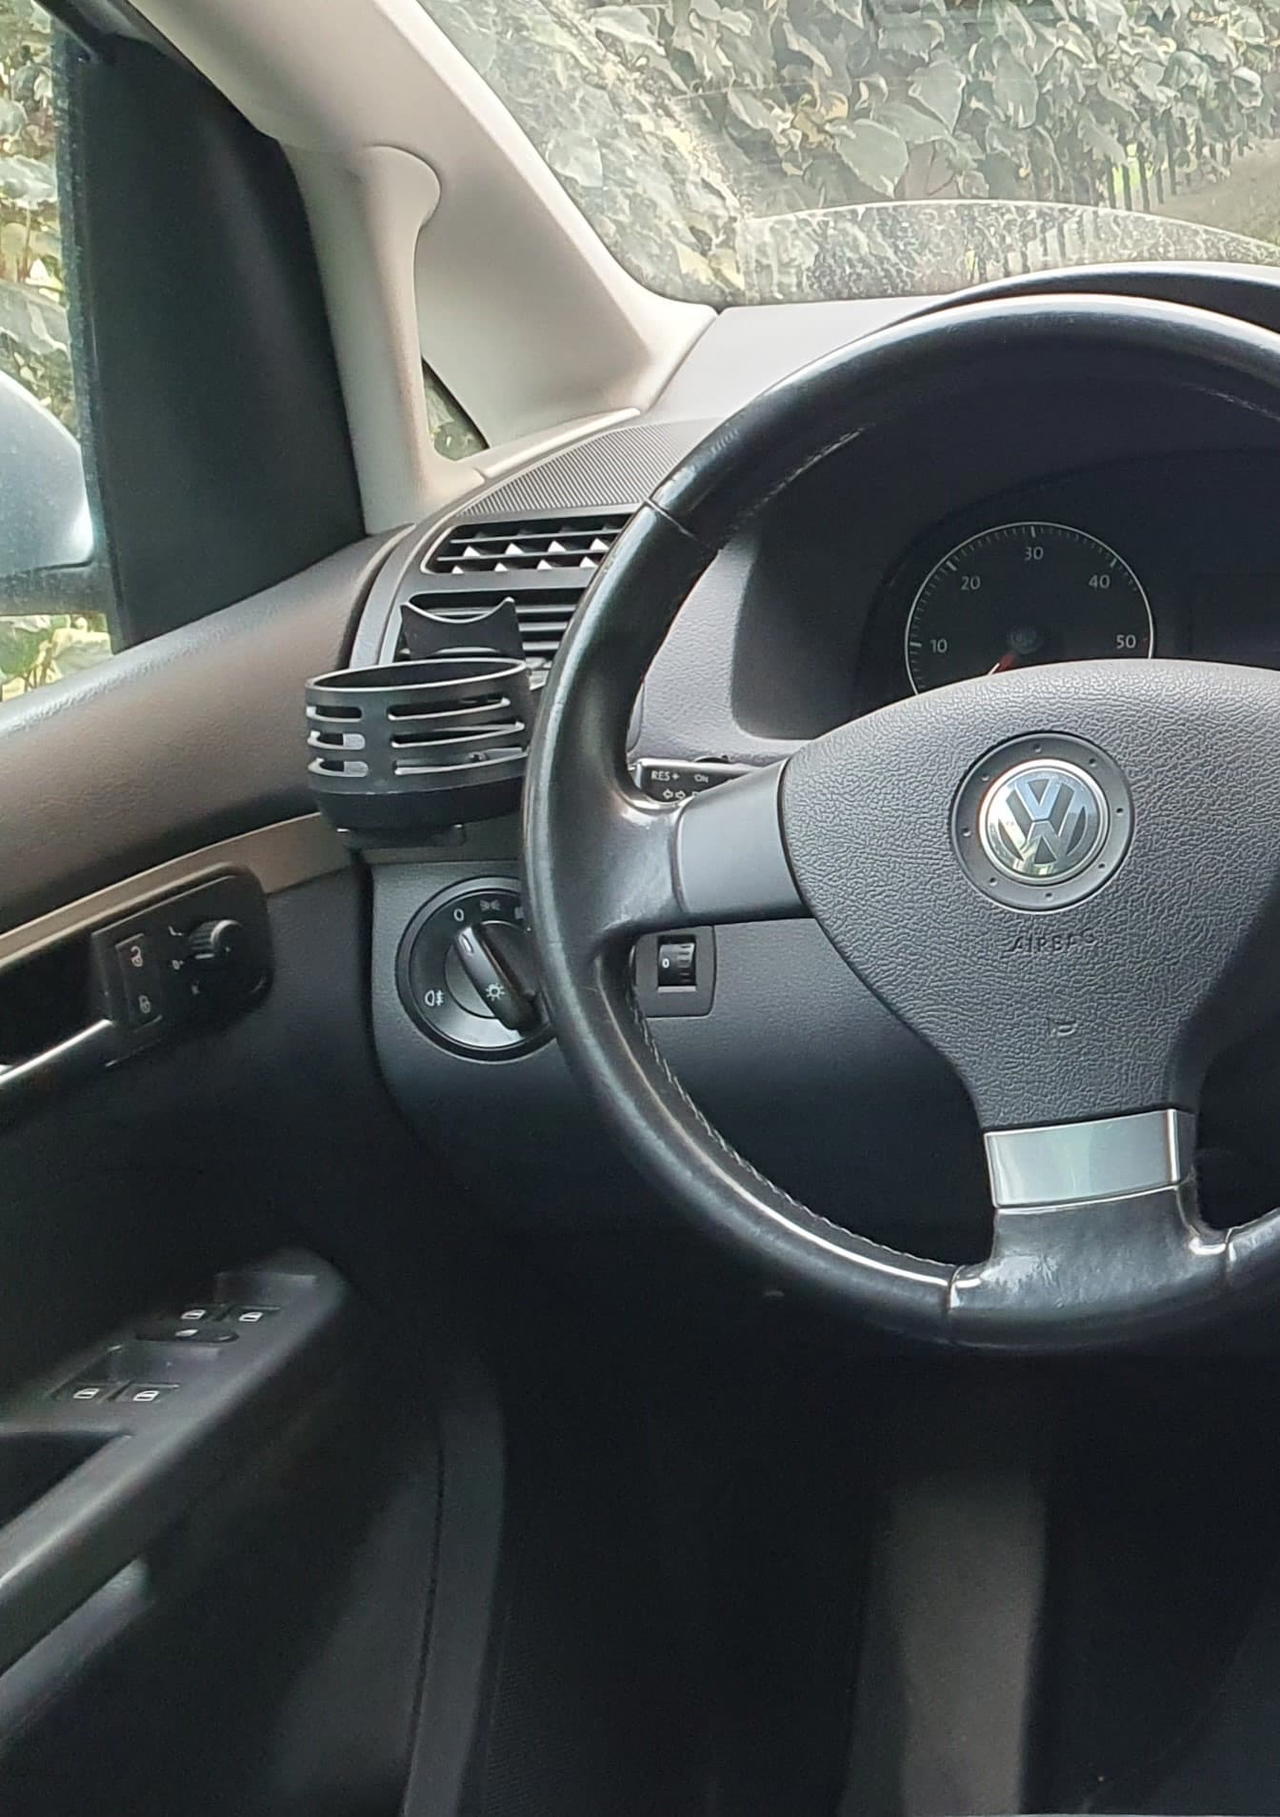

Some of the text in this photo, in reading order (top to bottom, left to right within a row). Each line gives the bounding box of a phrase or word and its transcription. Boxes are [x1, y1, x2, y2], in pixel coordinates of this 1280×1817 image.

[1024, 546, 1044, 561] 30
[961, 575, 982, 590] 20
[1088, 574, 1111, 590] 40
[930, 638, 948, 654] 10
[1115, 634, 1137, 650] 50
